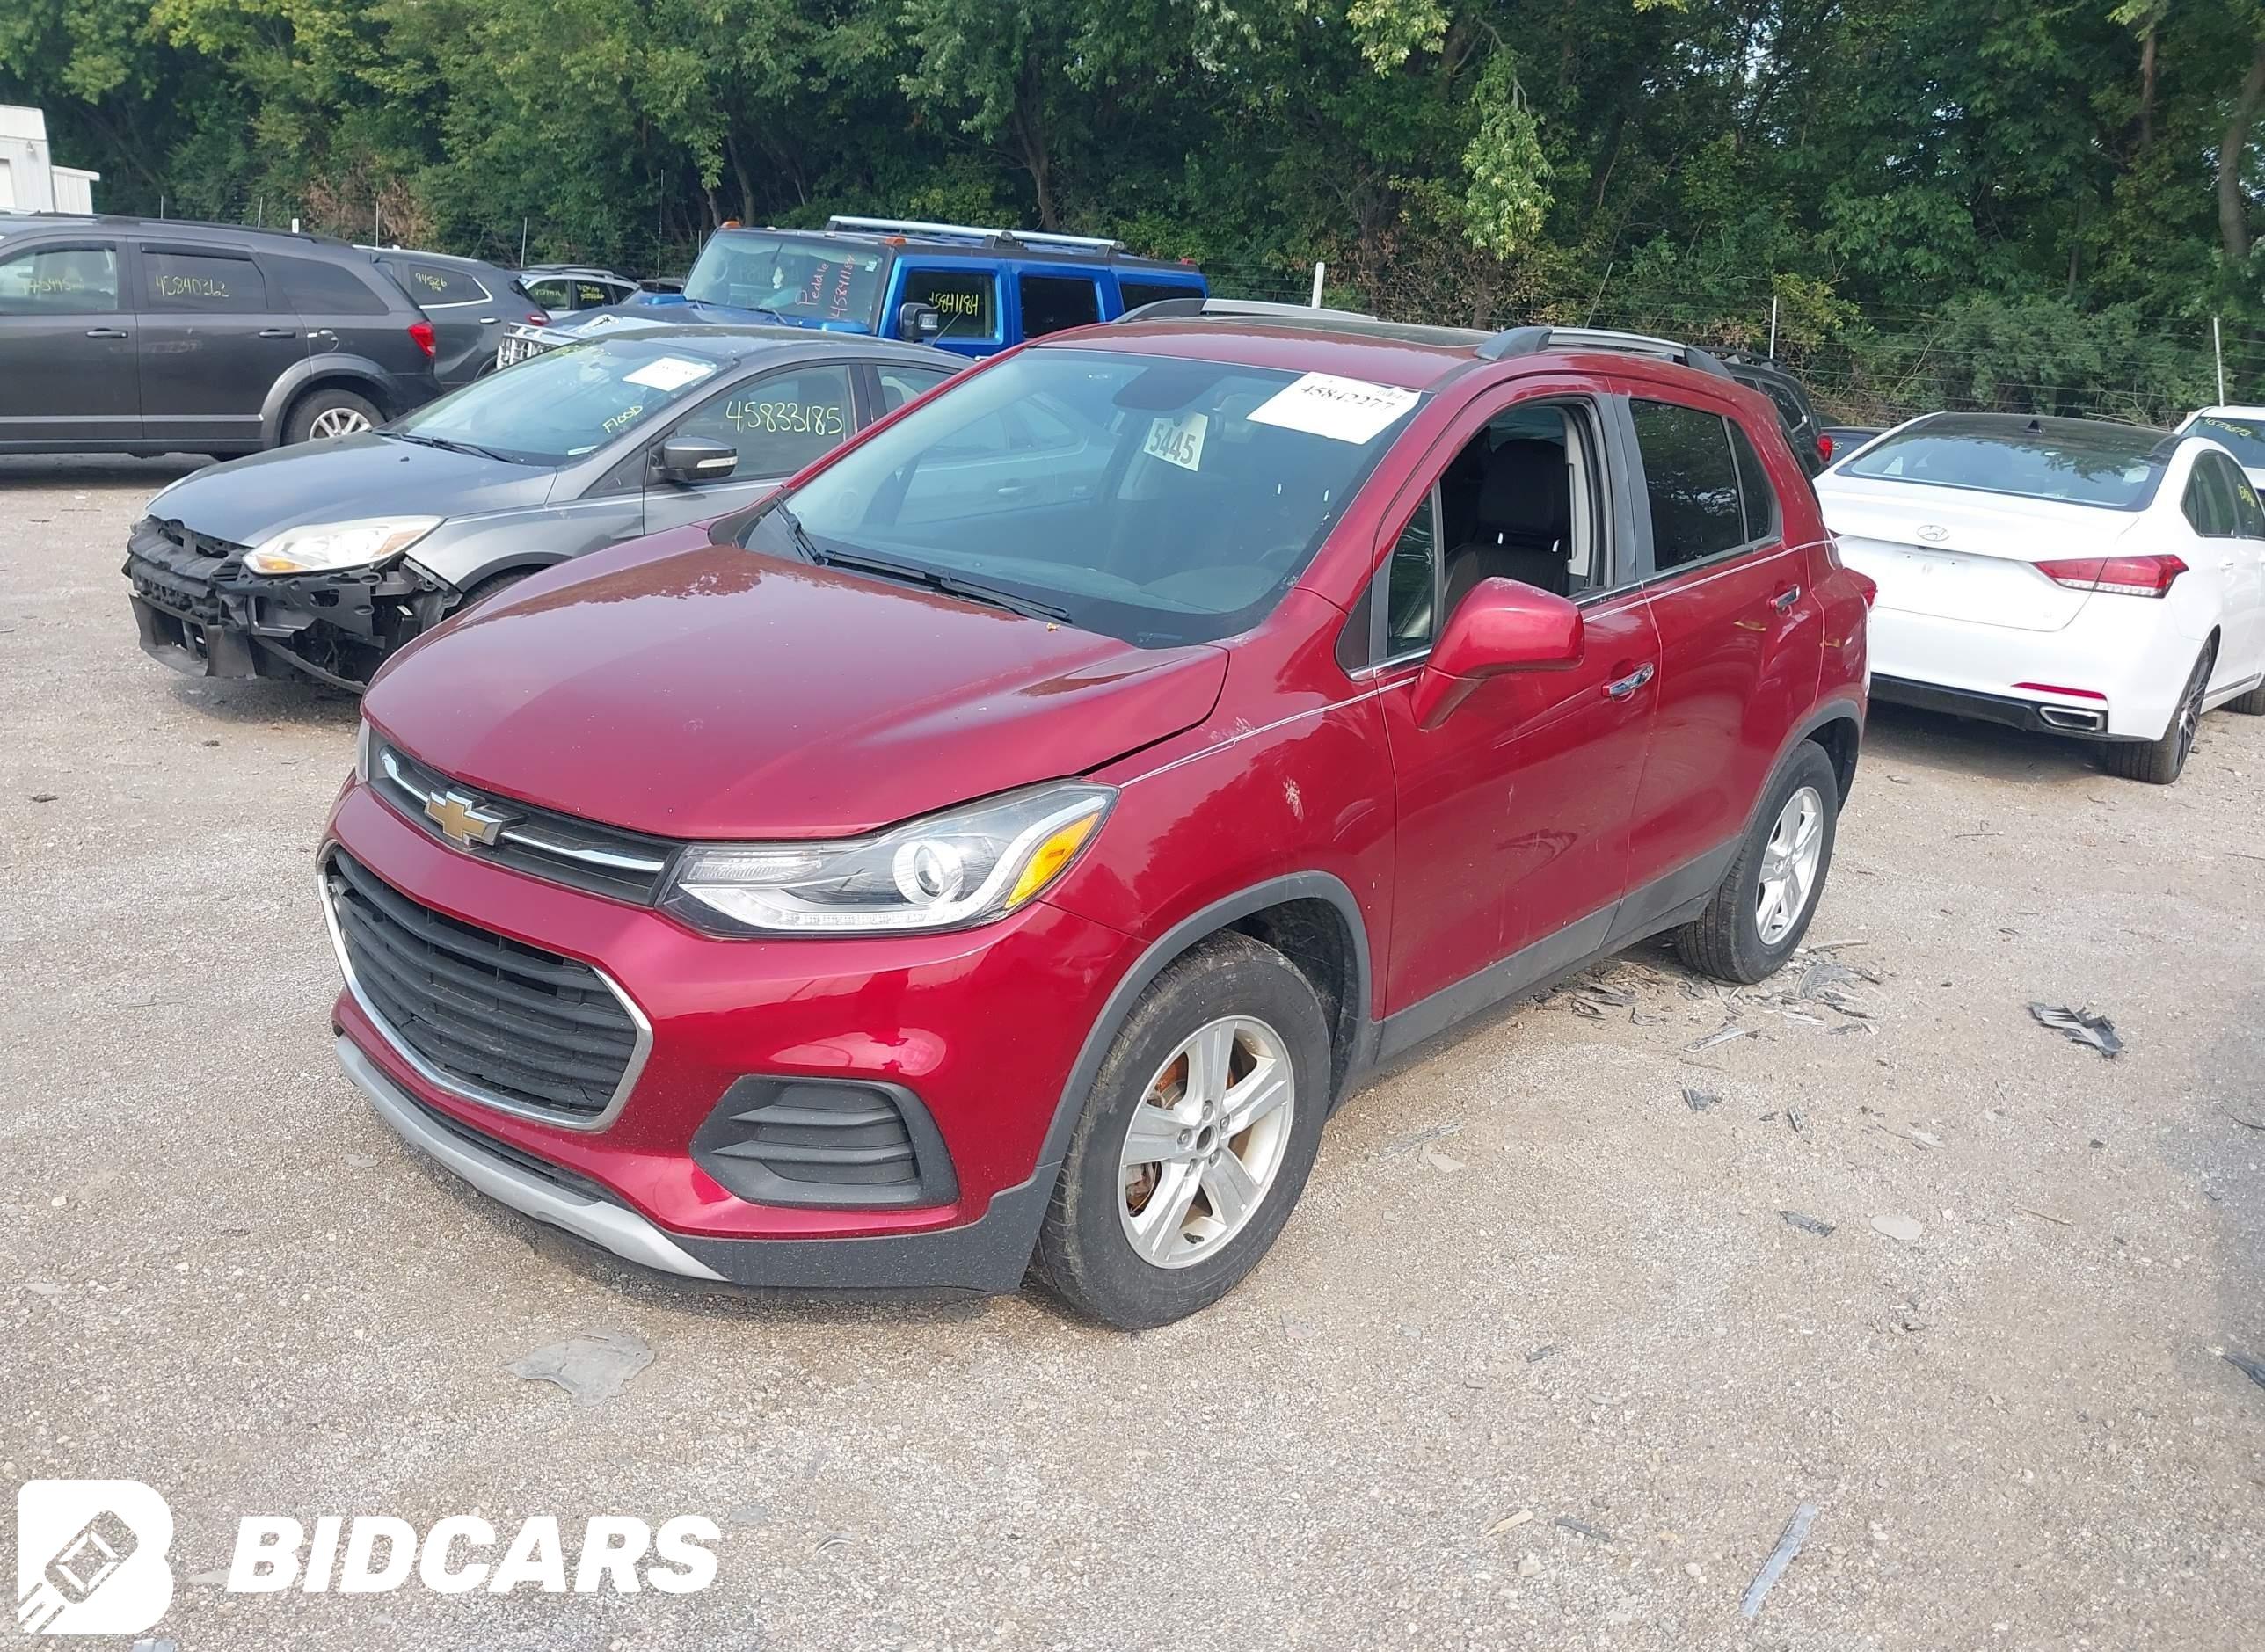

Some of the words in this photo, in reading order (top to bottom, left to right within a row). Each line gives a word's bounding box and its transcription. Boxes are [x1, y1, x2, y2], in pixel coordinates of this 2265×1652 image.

[929, 291, 979, 317] 45841184
[725, 400, 843, 436] 45833185
[1149, 423, 1197, 465] 5445
